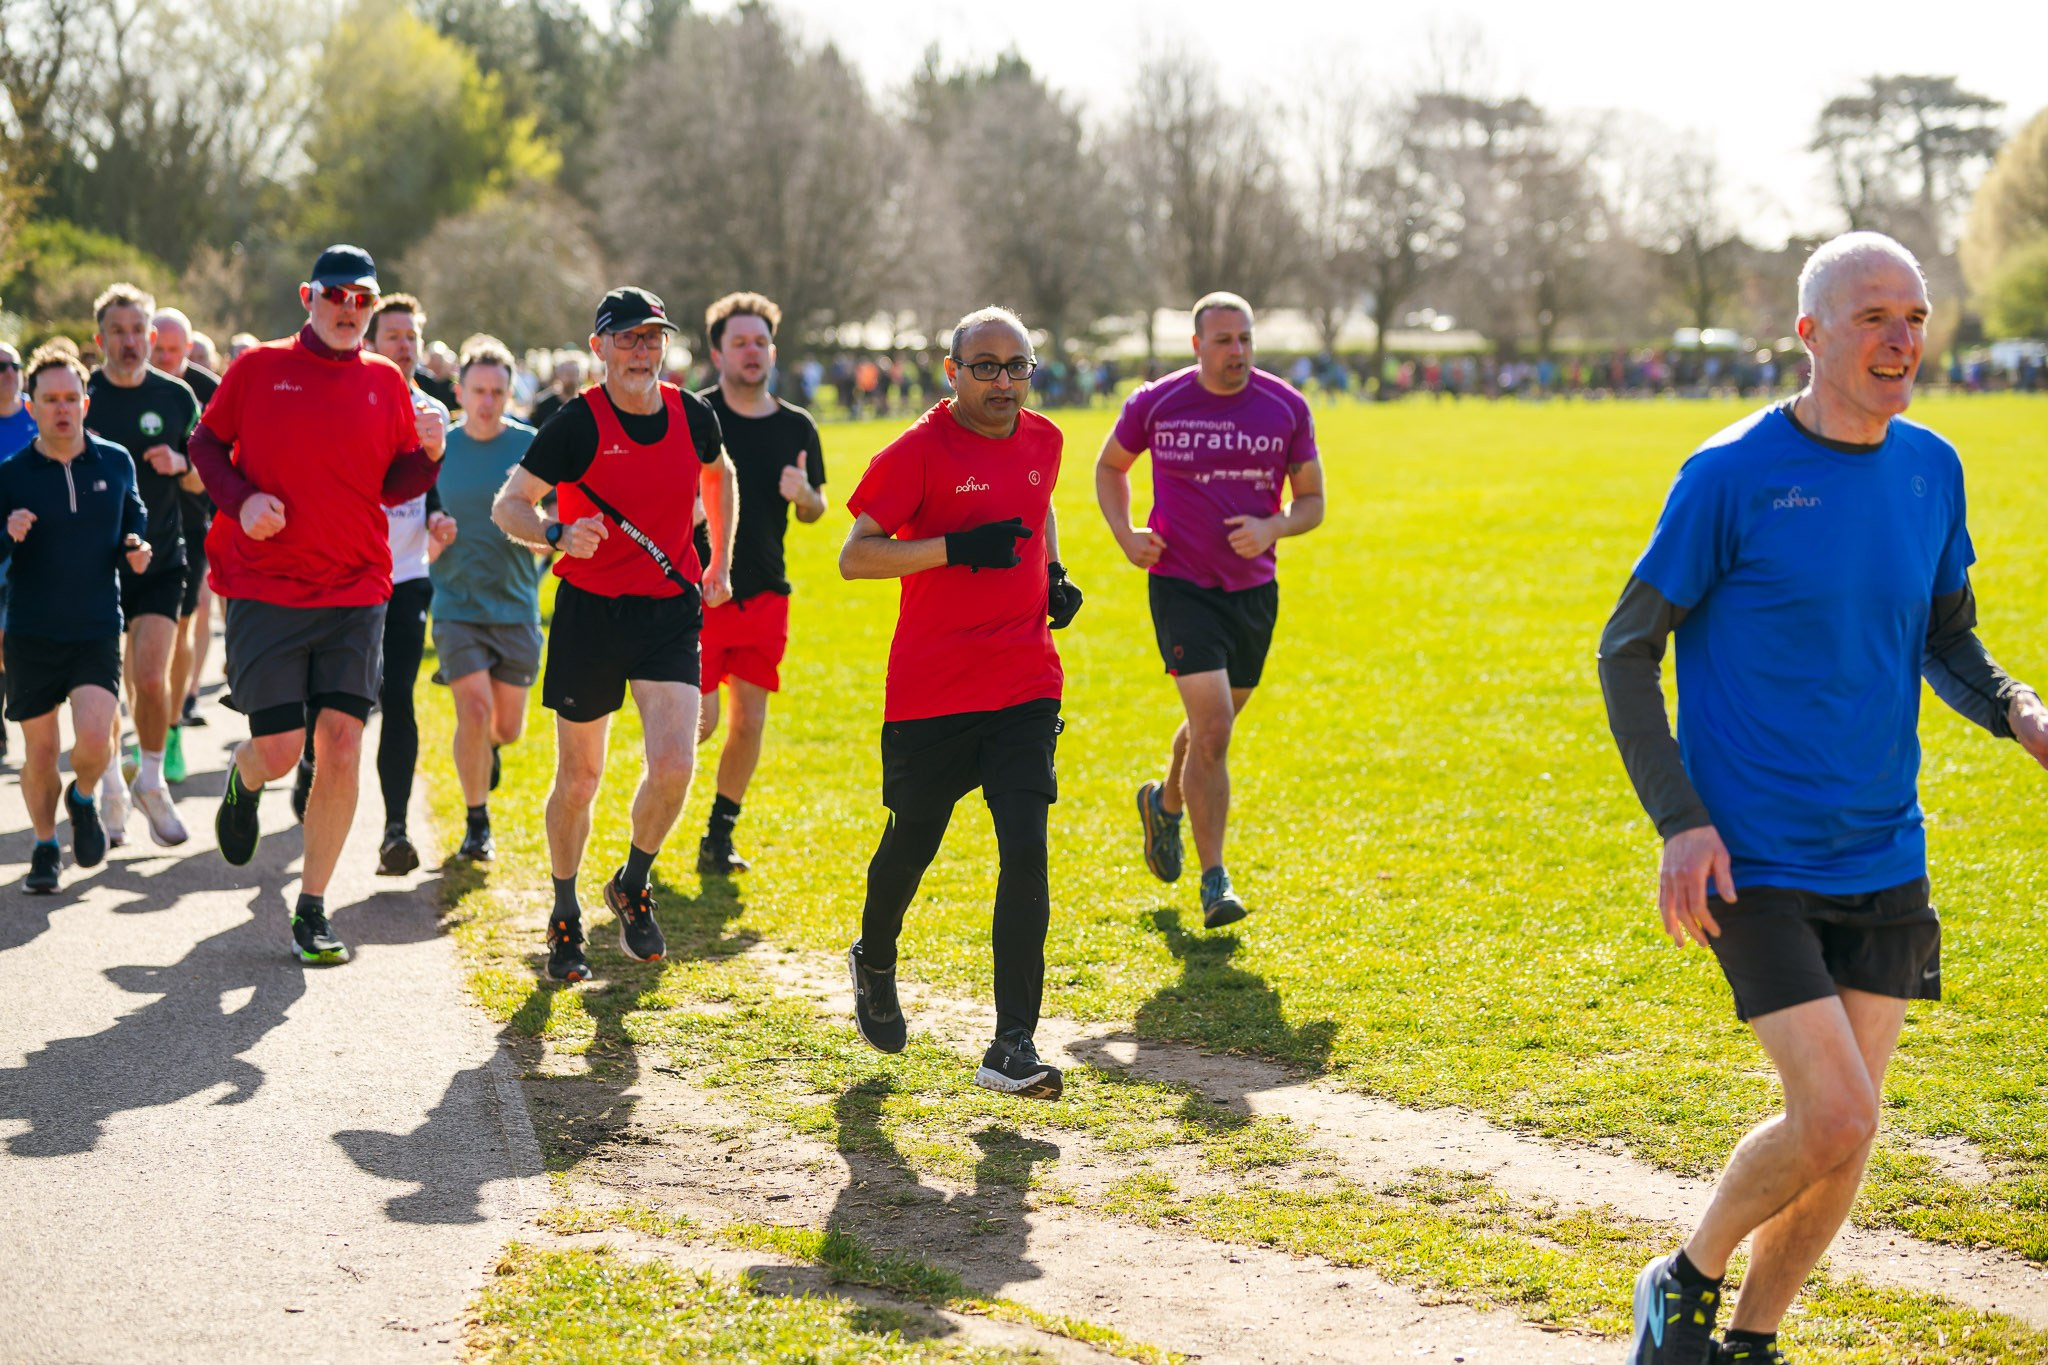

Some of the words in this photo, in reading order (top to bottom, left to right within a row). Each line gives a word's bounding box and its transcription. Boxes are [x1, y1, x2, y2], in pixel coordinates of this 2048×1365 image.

[1155, 419, 1236, 432] bournemouth
[1154, 430, 1284, 453] marathon
[1155, 448, 1195, 462] festival
[955, 476, 990, 494] parkrun
[1773, 486, 1822, 510] parkrun
[620, 519, 665, 563] WIMBORNE
[660, 560, 672, 575] AC
